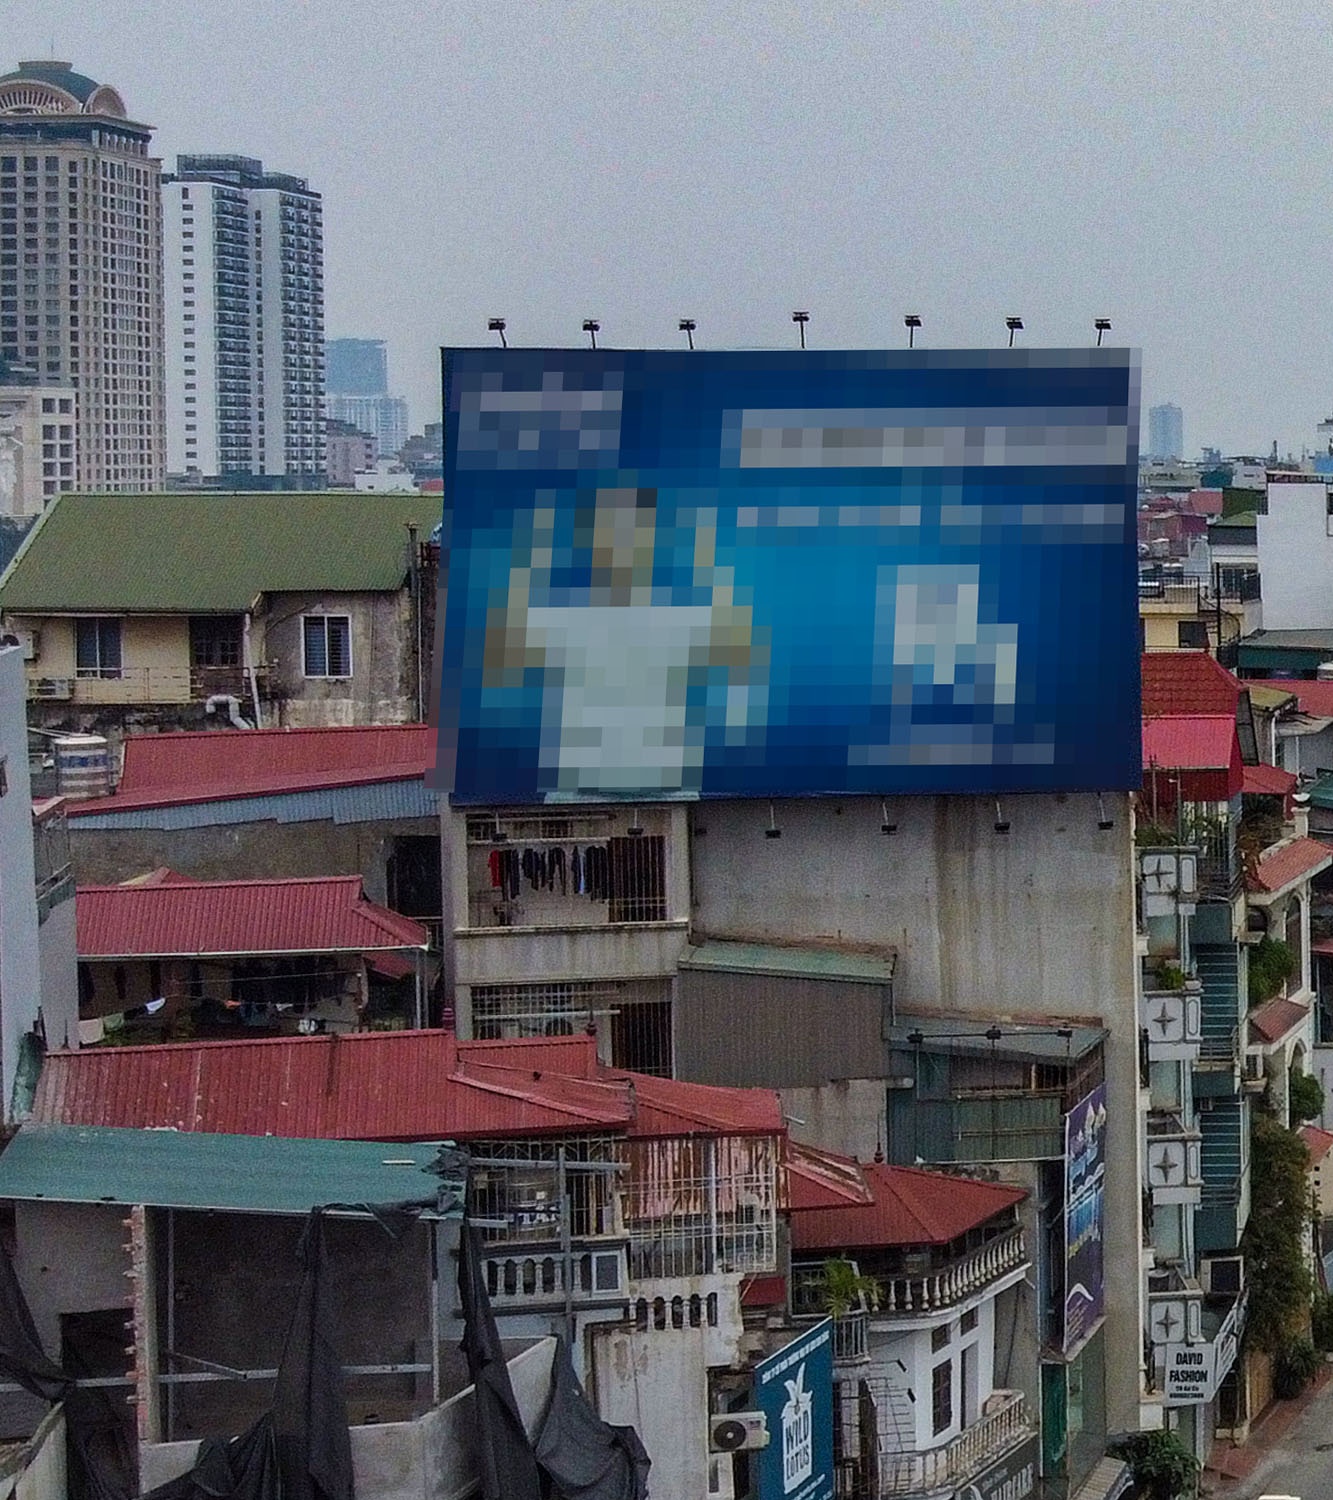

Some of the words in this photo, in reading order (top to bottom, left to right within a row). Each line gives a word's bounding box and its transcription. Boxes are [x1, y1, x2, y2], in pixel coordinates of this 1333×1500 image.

[1176, 1352, 1203, 1366] DAVID
[1169, 1369, 1208, 1382] FASHION
[785, 1410, 810, 1455] WILD
[786, 1443, 810, 1480] LOTUS
